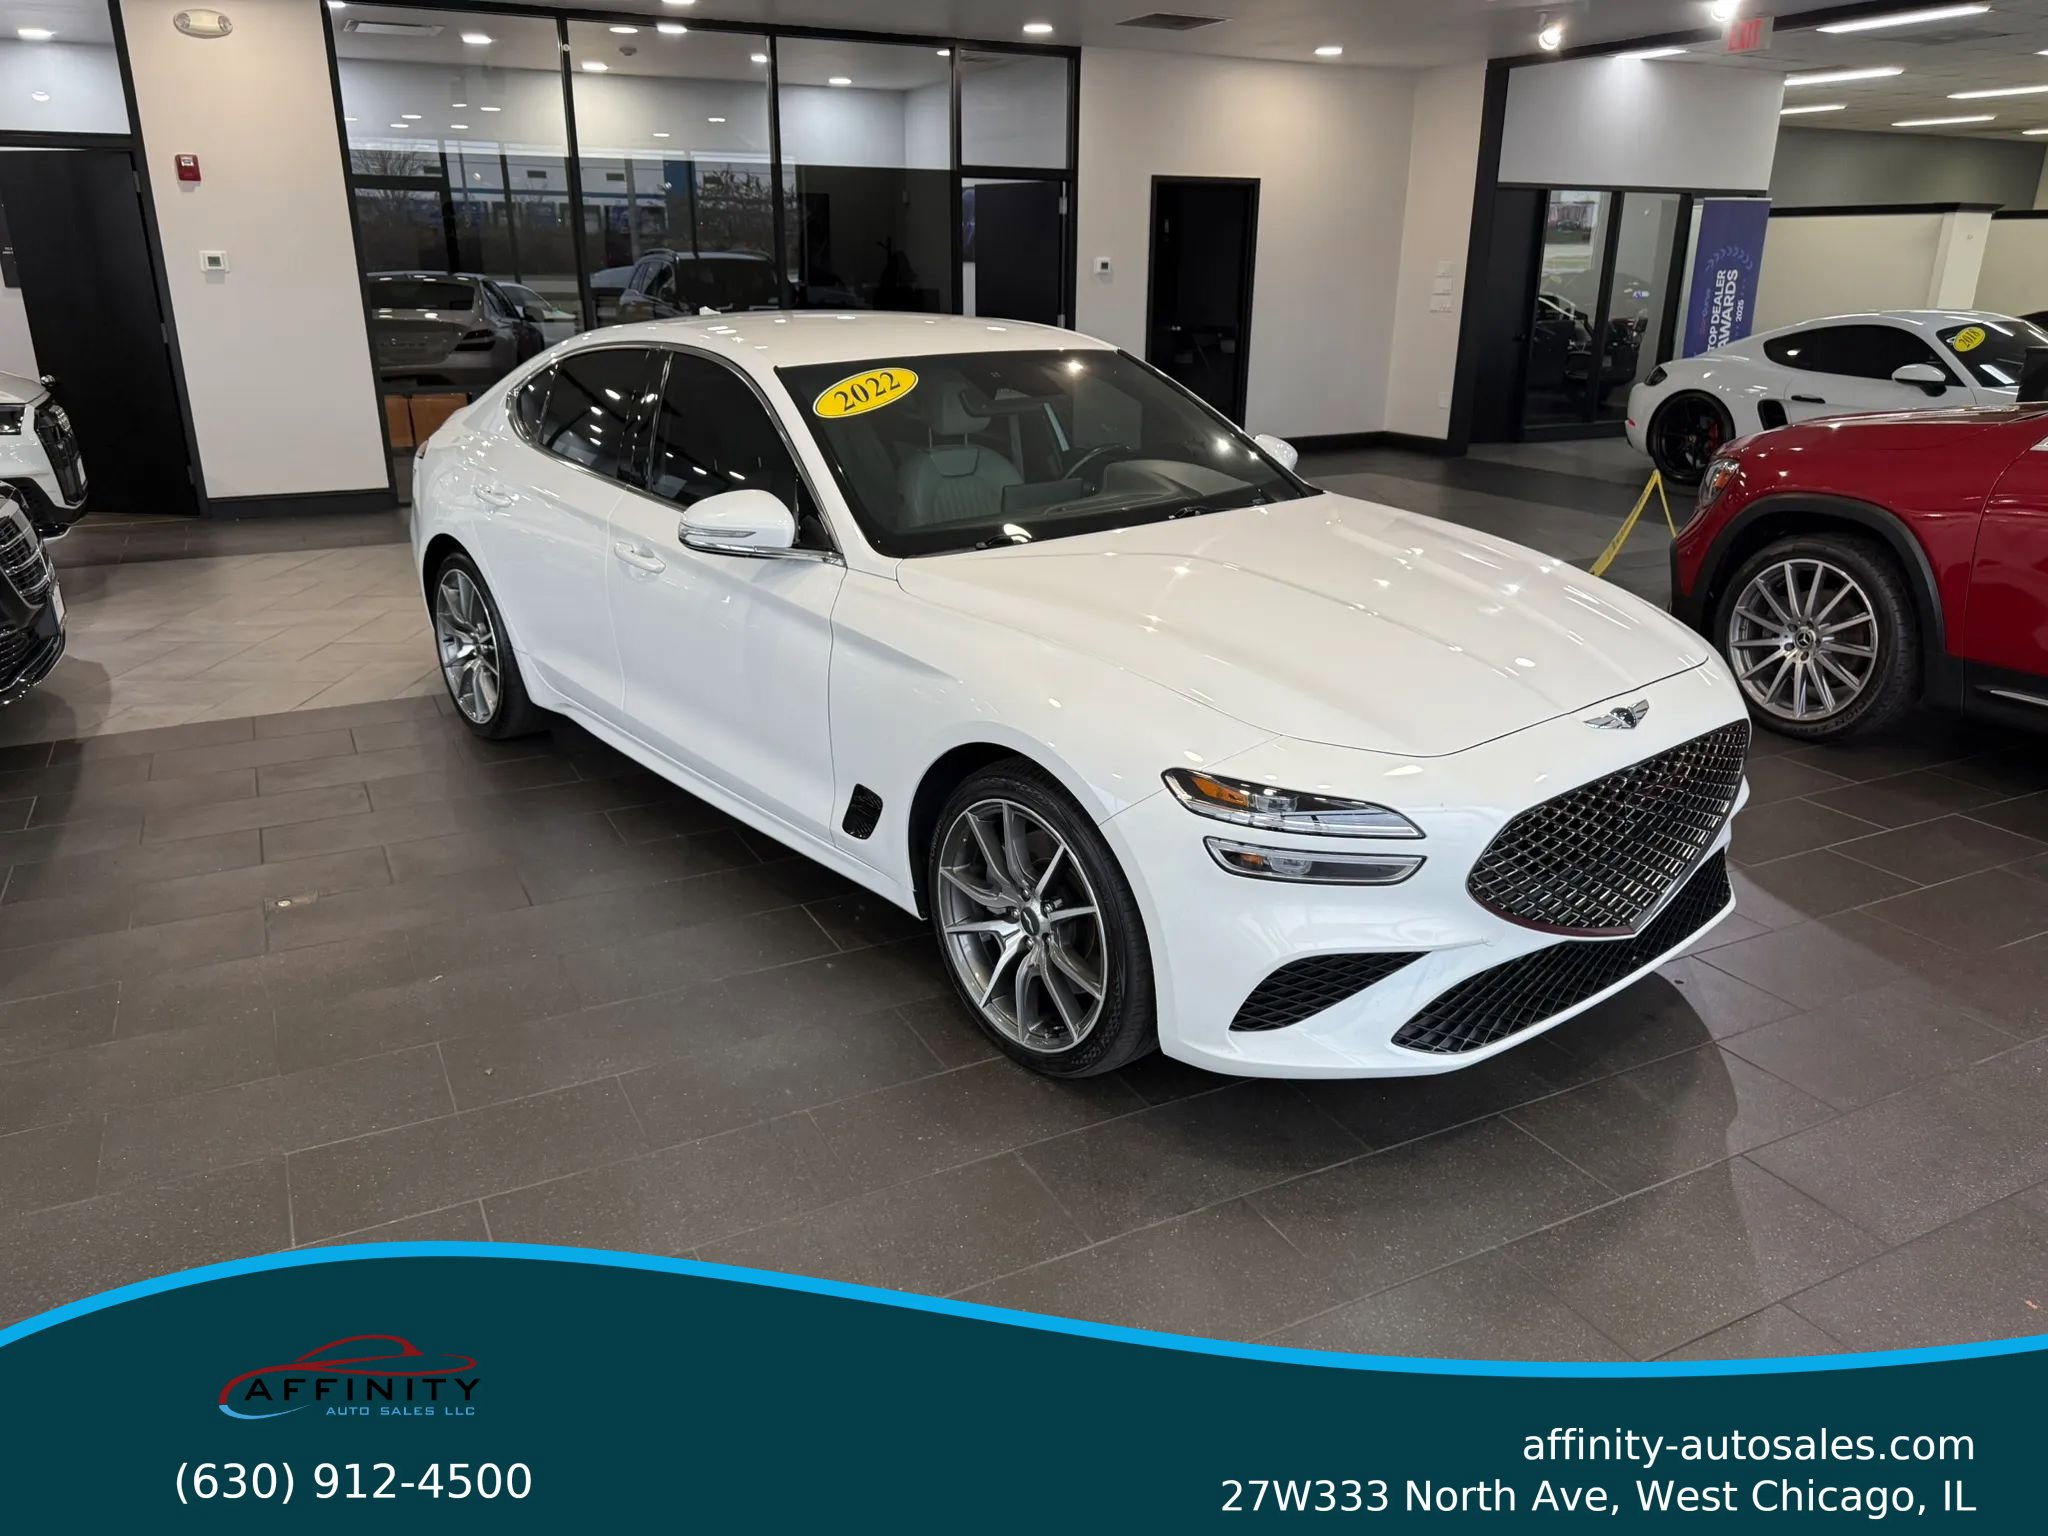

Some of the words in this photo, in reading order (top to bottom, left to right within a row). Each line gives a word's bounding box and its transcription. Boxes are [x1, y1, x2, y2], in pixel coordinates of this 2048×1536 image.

[1711, 270, 1726, 324] DEALER
[1718, 269, 1738, 348] AWARDS
[1707, 326, 1718, 352] TOP
[834, 372, 900, 411] 2022
